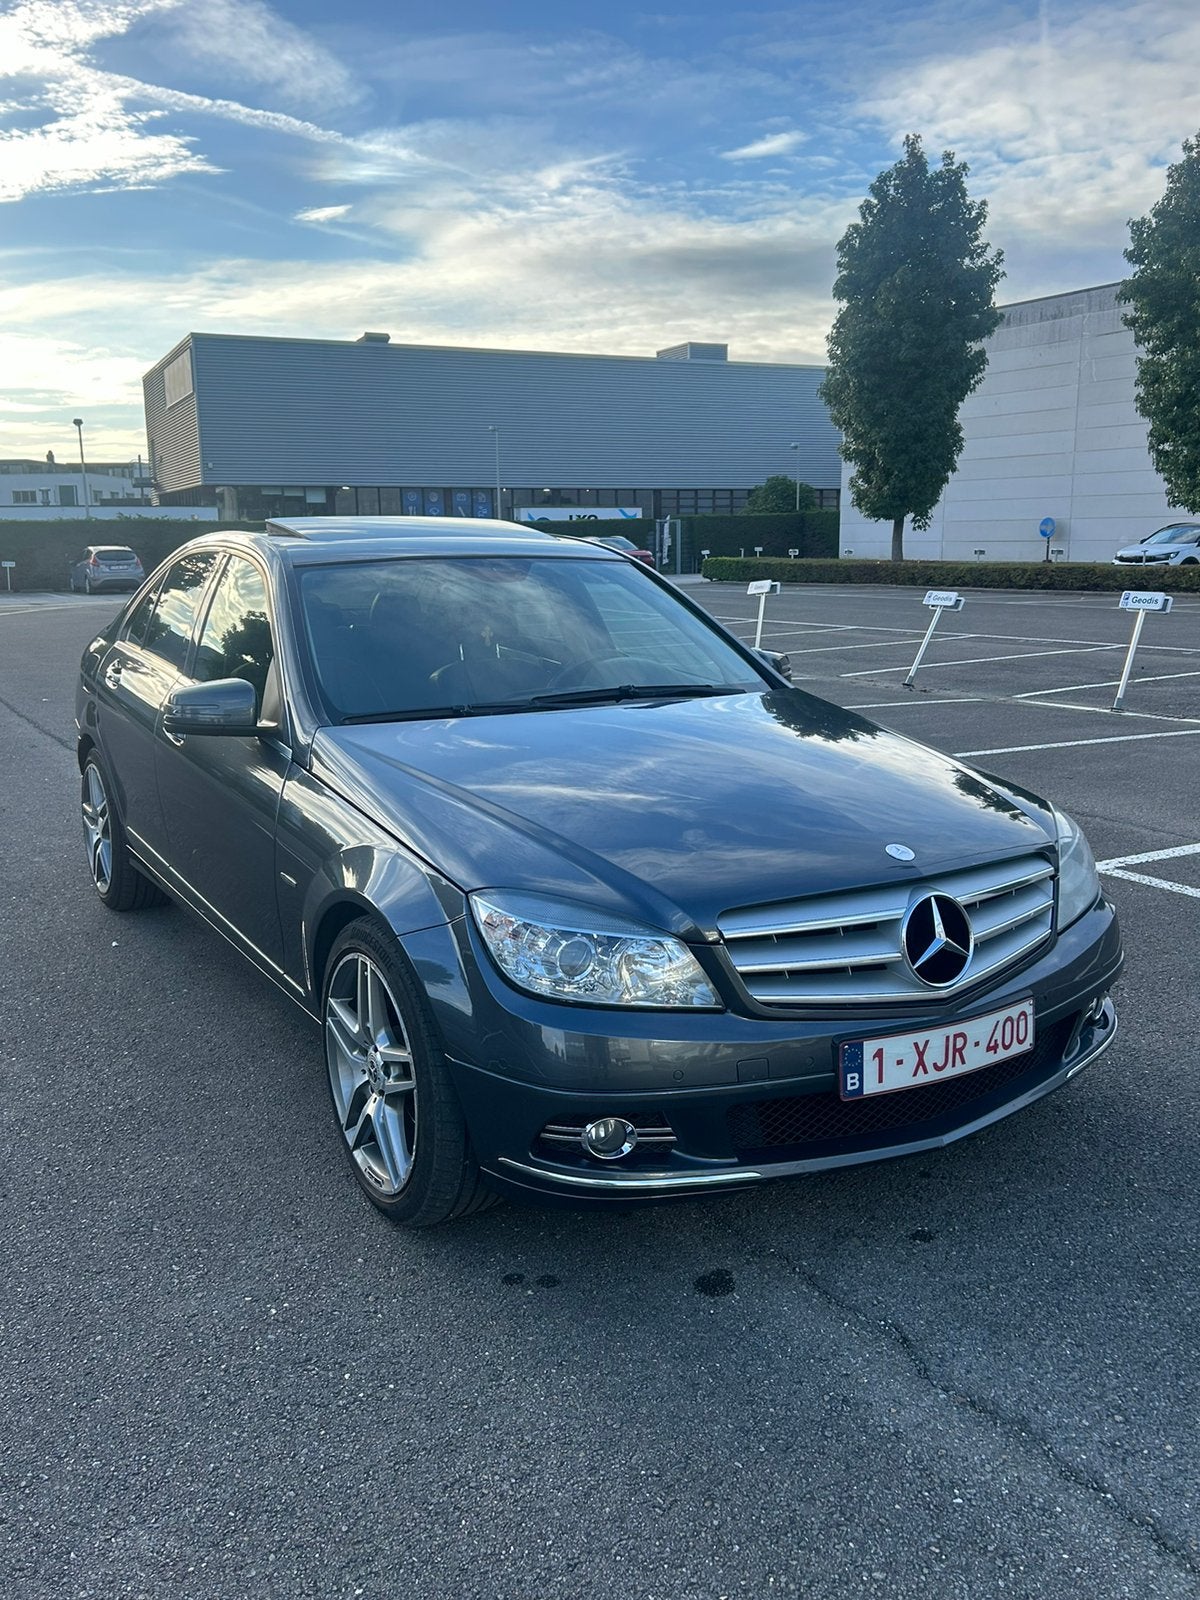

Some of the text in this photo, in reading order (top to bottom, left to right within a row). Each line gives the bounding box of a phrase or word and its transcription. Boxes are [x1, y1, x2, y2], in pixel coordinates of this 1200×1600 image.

[1131, 596, 1159, 605] Geodis
[872, 1010, 1028, 1084] 1-XJR-400
[846, 1072, 860, 1091] B
